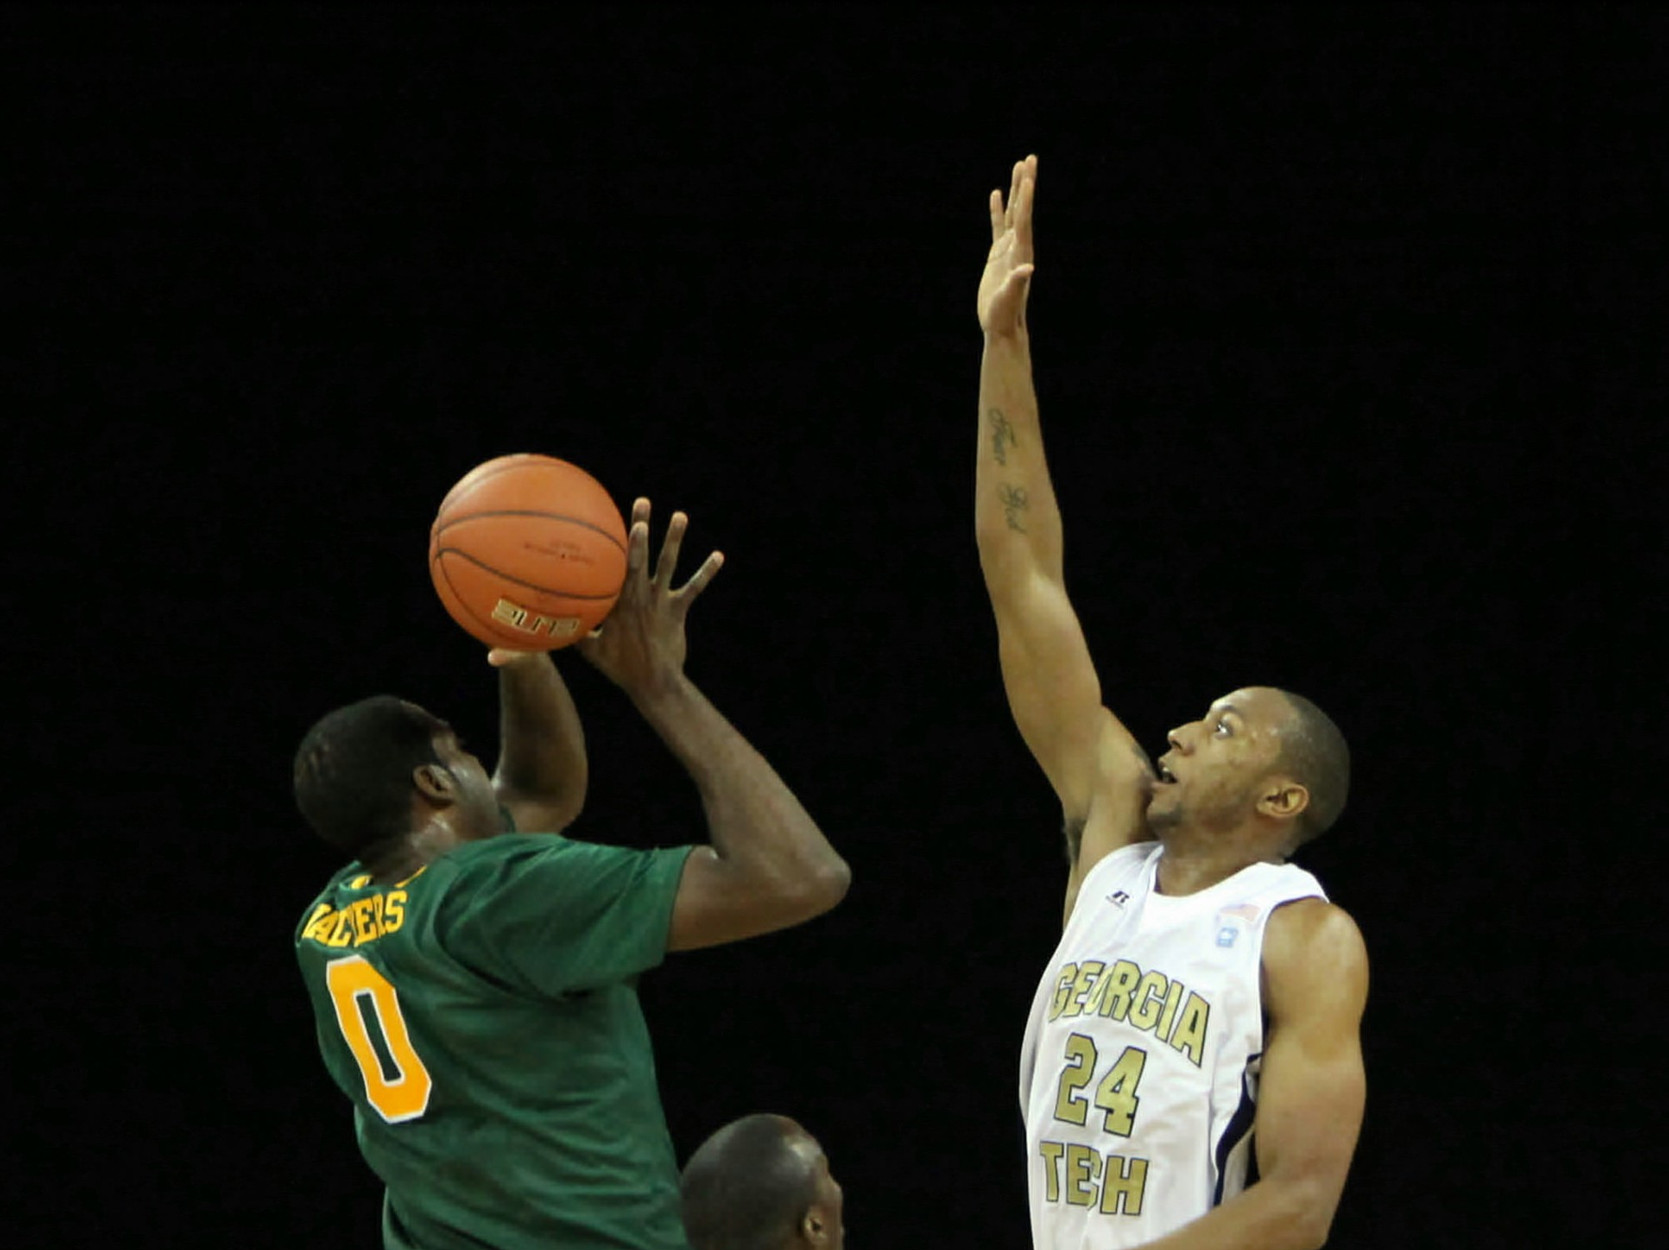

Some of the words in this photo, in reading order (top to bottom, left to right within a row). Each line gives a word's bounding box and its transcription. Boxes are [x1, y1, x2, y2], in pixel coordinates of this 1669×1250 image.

[326, 953, 432, 1124] 0
[1048, 958, 1211, 1069] GEORGIA
[1053, 1032, 1147, 1139] 24
